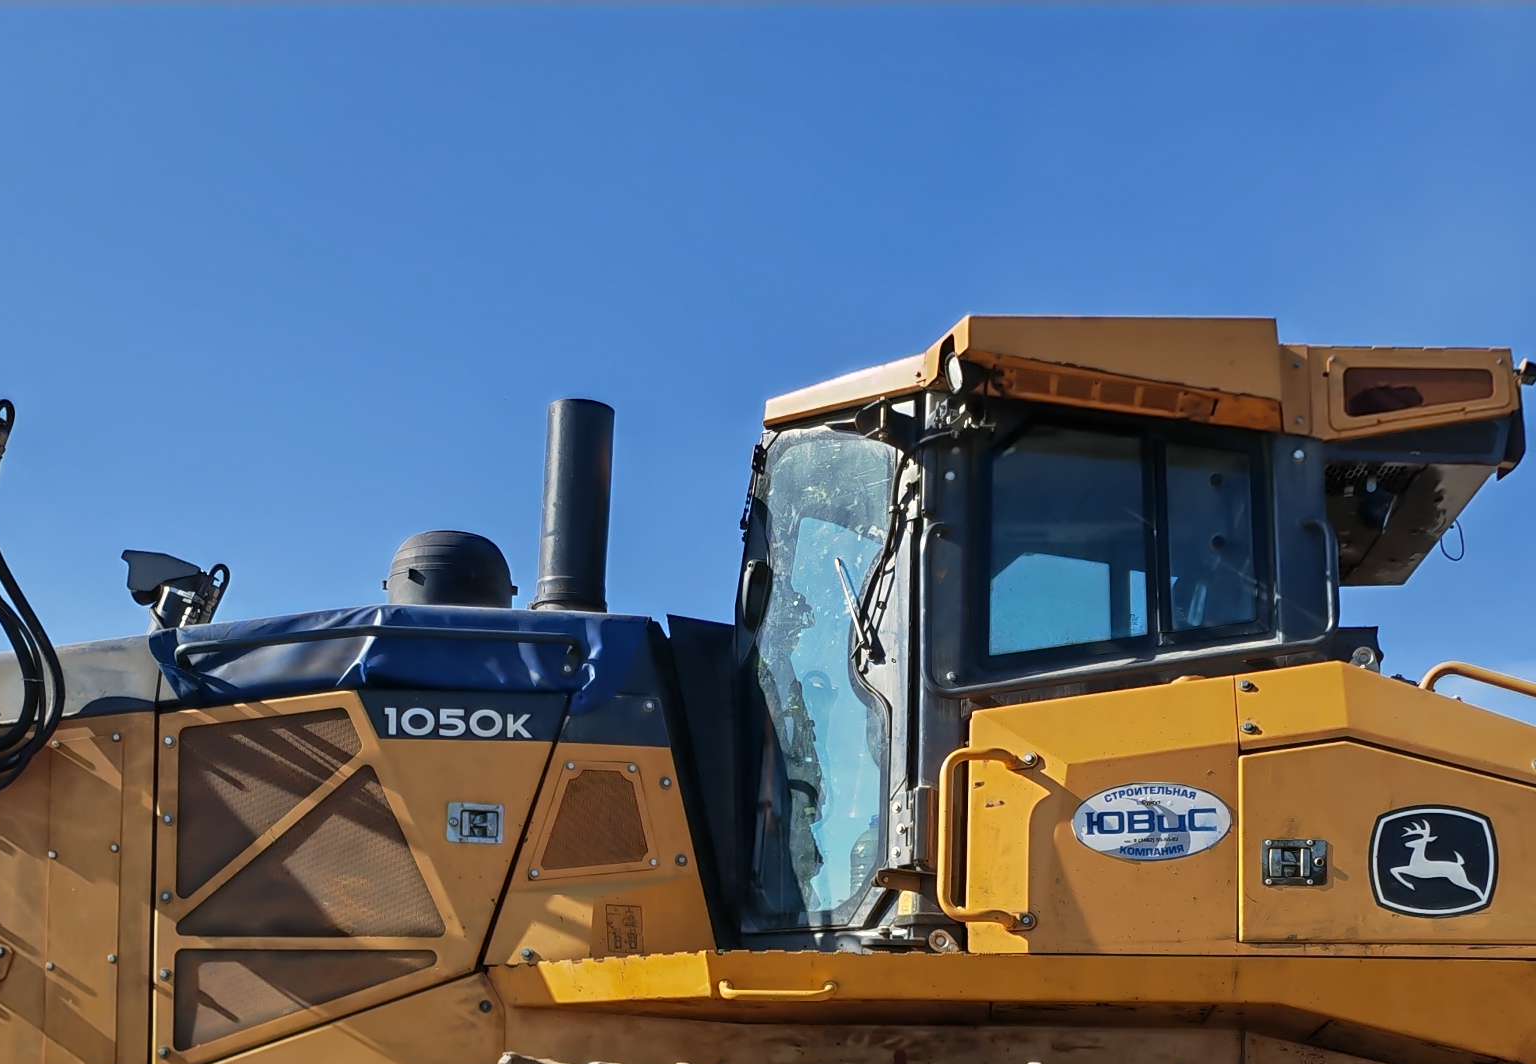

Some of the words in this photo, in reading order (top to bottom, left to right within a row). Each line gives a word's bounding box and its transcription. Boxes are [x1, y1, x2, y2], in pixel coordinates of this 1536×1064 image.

[384, 707, 533, 738] 1050K
[1104, 786, 1197, 803] СТРОИТЕЛЬНАЯ
[1119, 844, 1185, 857] КОМПАНИЯ
